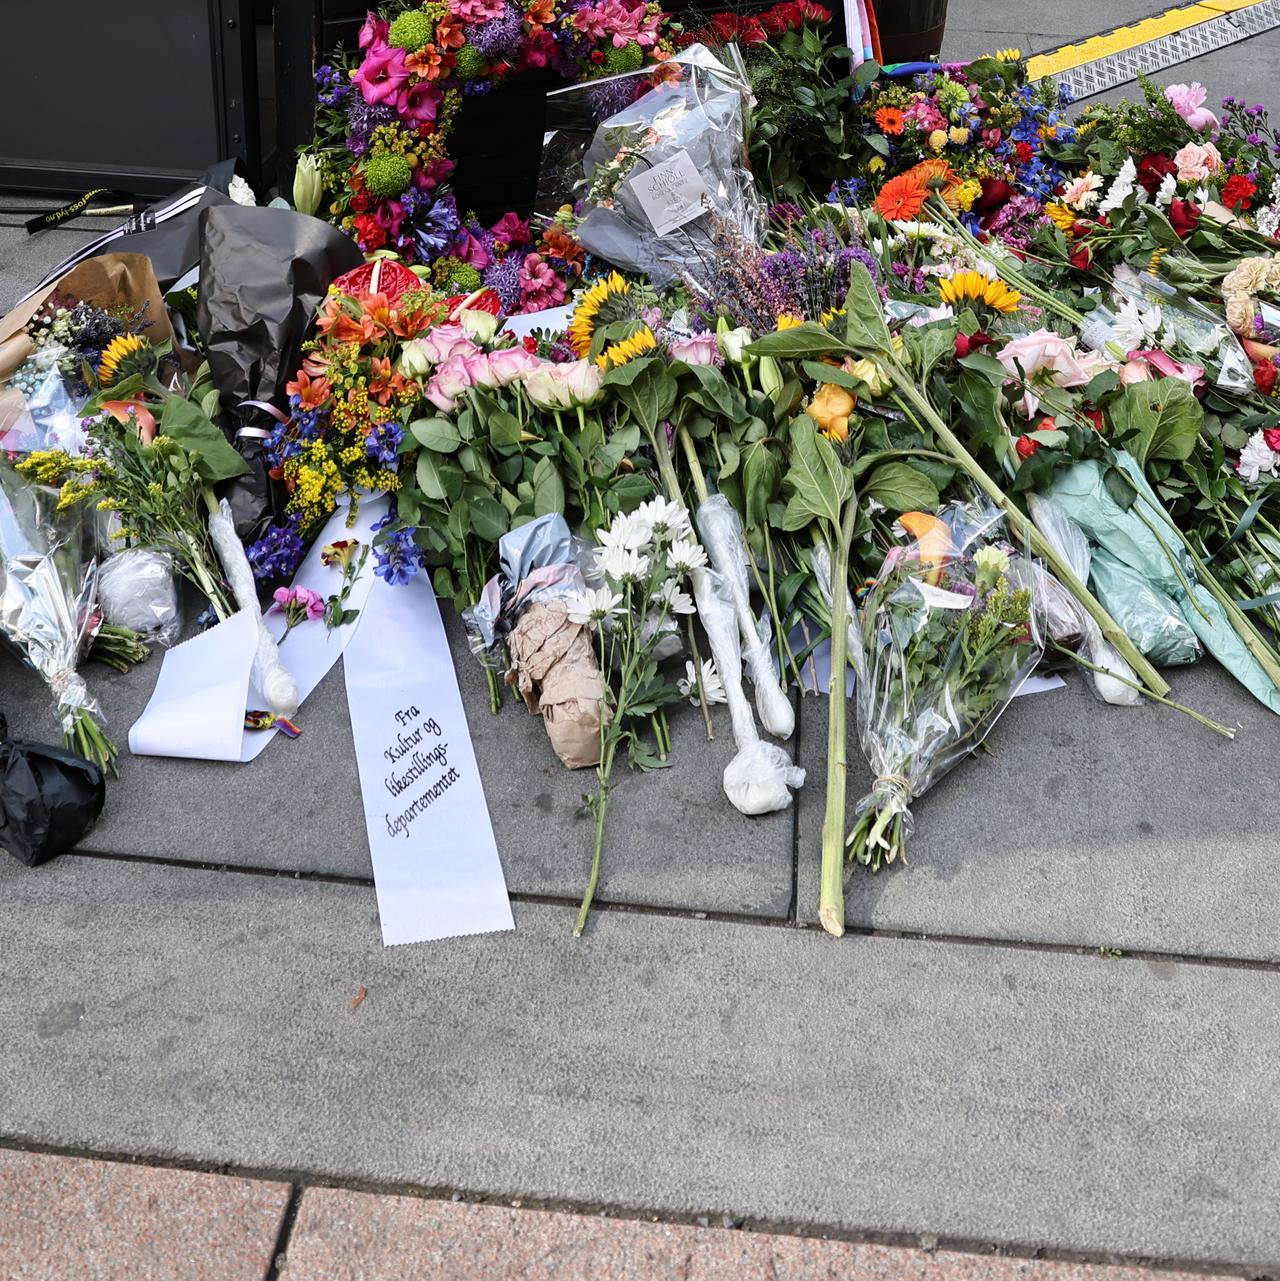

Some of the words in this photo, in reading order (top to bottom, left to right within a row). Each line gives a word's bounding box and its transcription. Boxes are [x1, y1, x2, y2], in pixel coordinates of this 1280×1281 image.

[383, 727, 424, 765] Kultur
[423, 717, 442, 737] og
[394, 705, 421, 727] Fra
[384, 742, 449, 798] likestillings-
[385, 767, 461, 839] departementet
